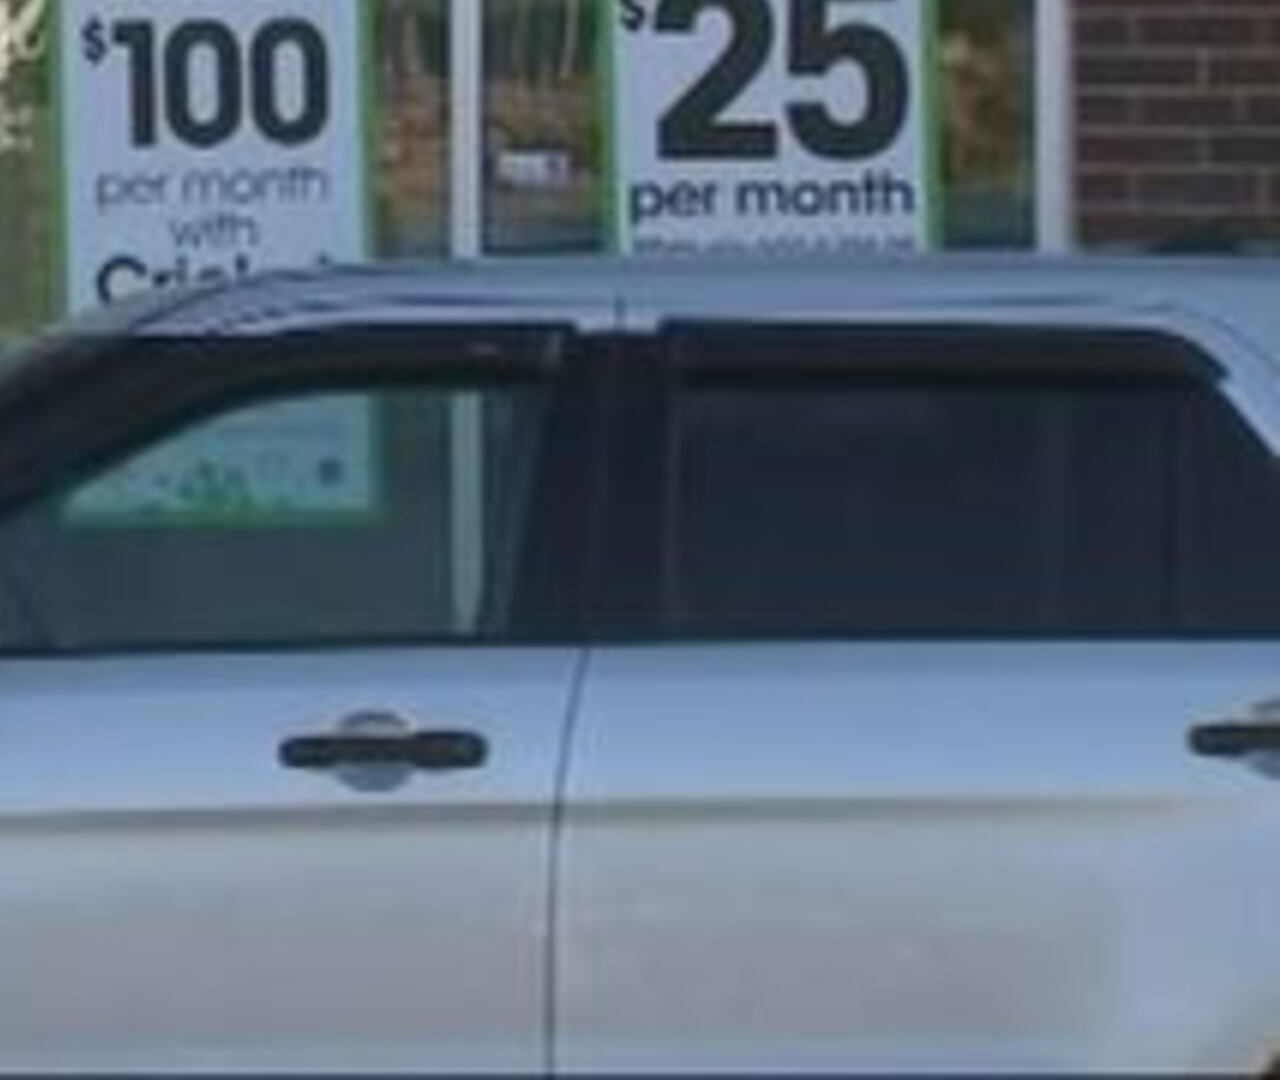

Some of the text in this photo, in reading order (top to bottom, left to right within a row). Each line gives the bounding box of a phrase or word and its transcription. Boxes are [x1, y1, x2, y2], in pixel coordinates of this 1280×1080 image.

[80, 15, 331, 151] $100
[96, 165, 332, 213] per month
[629, 169, 917, 223] per month
[168, 217, 261, 249] with
